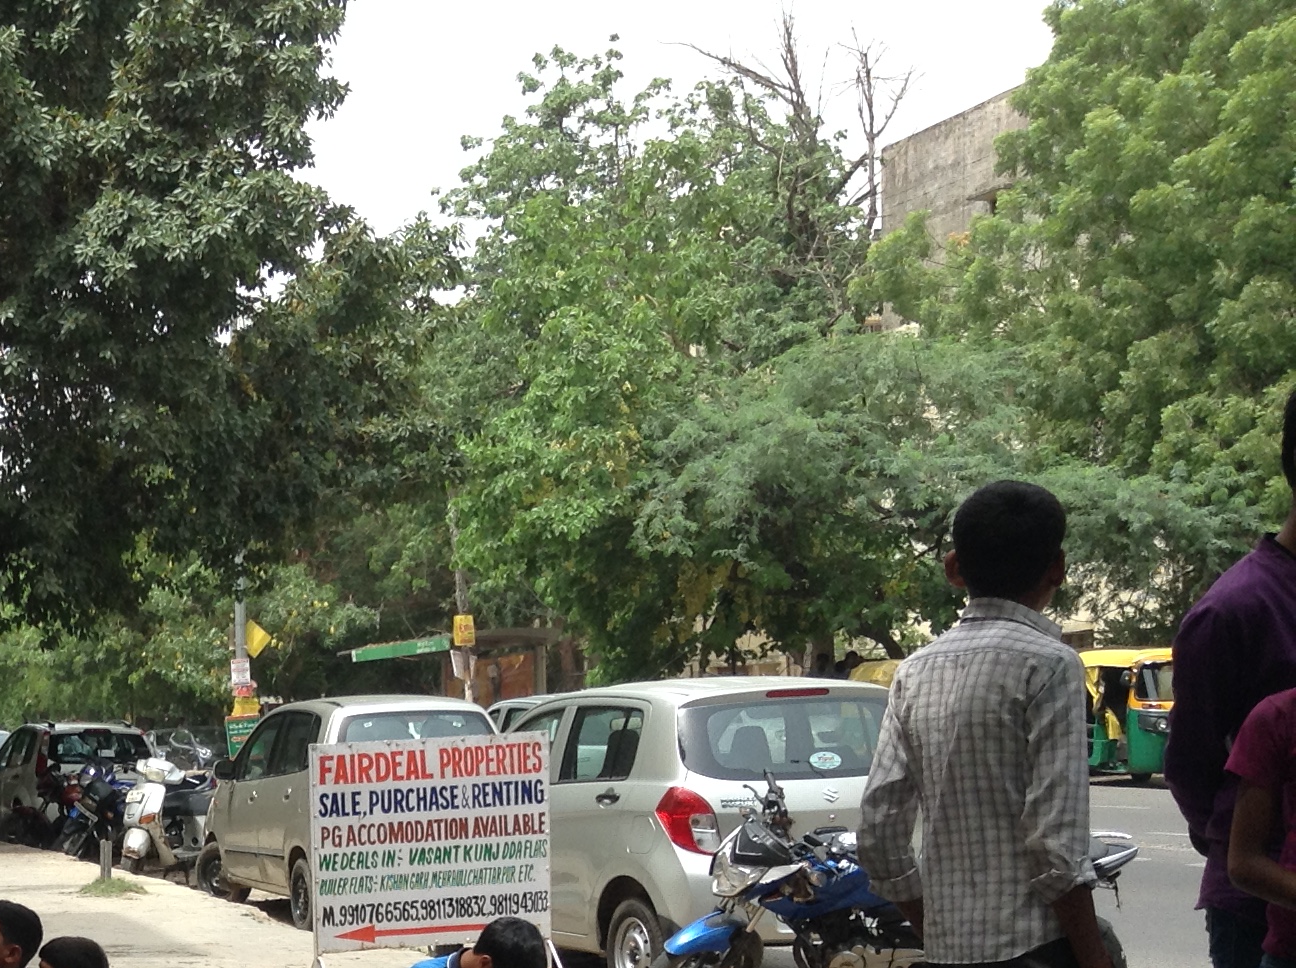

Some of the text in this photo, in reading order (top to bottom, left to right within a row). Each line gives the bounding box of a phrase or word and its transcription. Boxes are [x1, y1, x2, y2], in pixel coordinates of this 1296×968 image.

[319, 742, 542, 785] FAIRDEAL PROPERTIES
[320, 811, 546, 849] PG ACCOMODATION AVAILABLE
[318, 851, 341, 872] WE
[342, 849, 378, 870] DEALS
[408, 843, 461, 866] VASANT
[464, 841, 501, 863] KUNJ
[502, 840, 522, 860] DDA
[522, 838, 548, 859] FLATS
